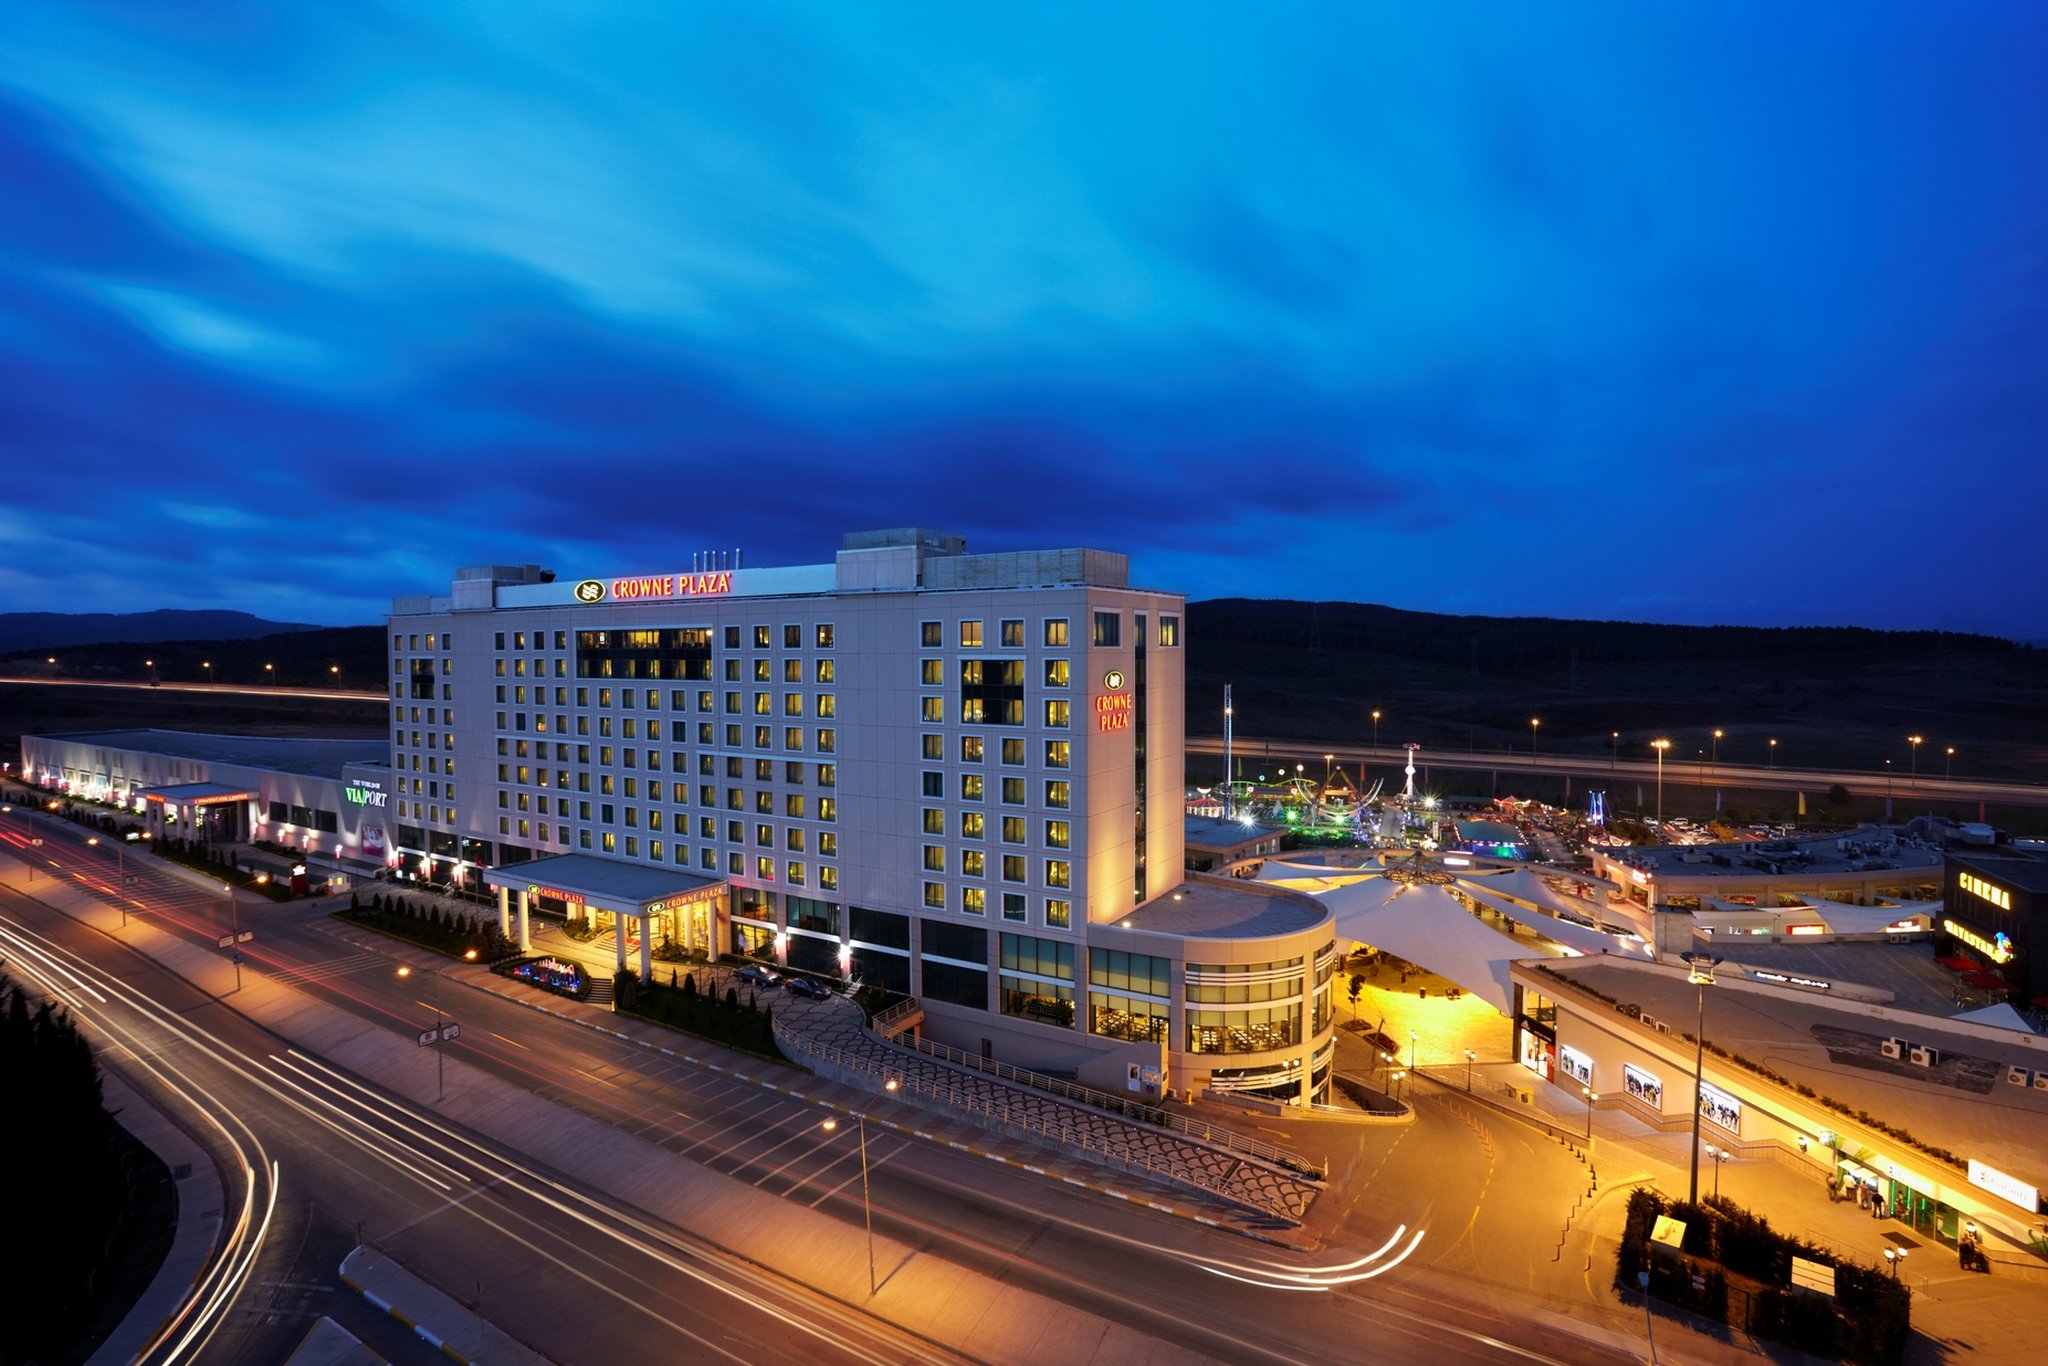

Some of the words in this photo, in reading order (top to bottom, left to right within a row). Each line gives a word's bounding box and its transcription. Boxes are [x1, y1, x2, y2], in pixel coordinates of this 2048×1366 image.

[612, 577, 673, 599] CROWNE
[679, 573, 731, 595] PLAZA
[1096, 694, 1131, 712] CROWNE
[1101, 712, 1129, 731] PLAZA
[541, 887, 564, 900] CROWNE
[564, 893, 584, 904] PLAZA
[666, 893, 698, 908] CROWNE
[700, 888, 722, 899] PLAZA
[1960, 872, 2010, 910] CINEMA
